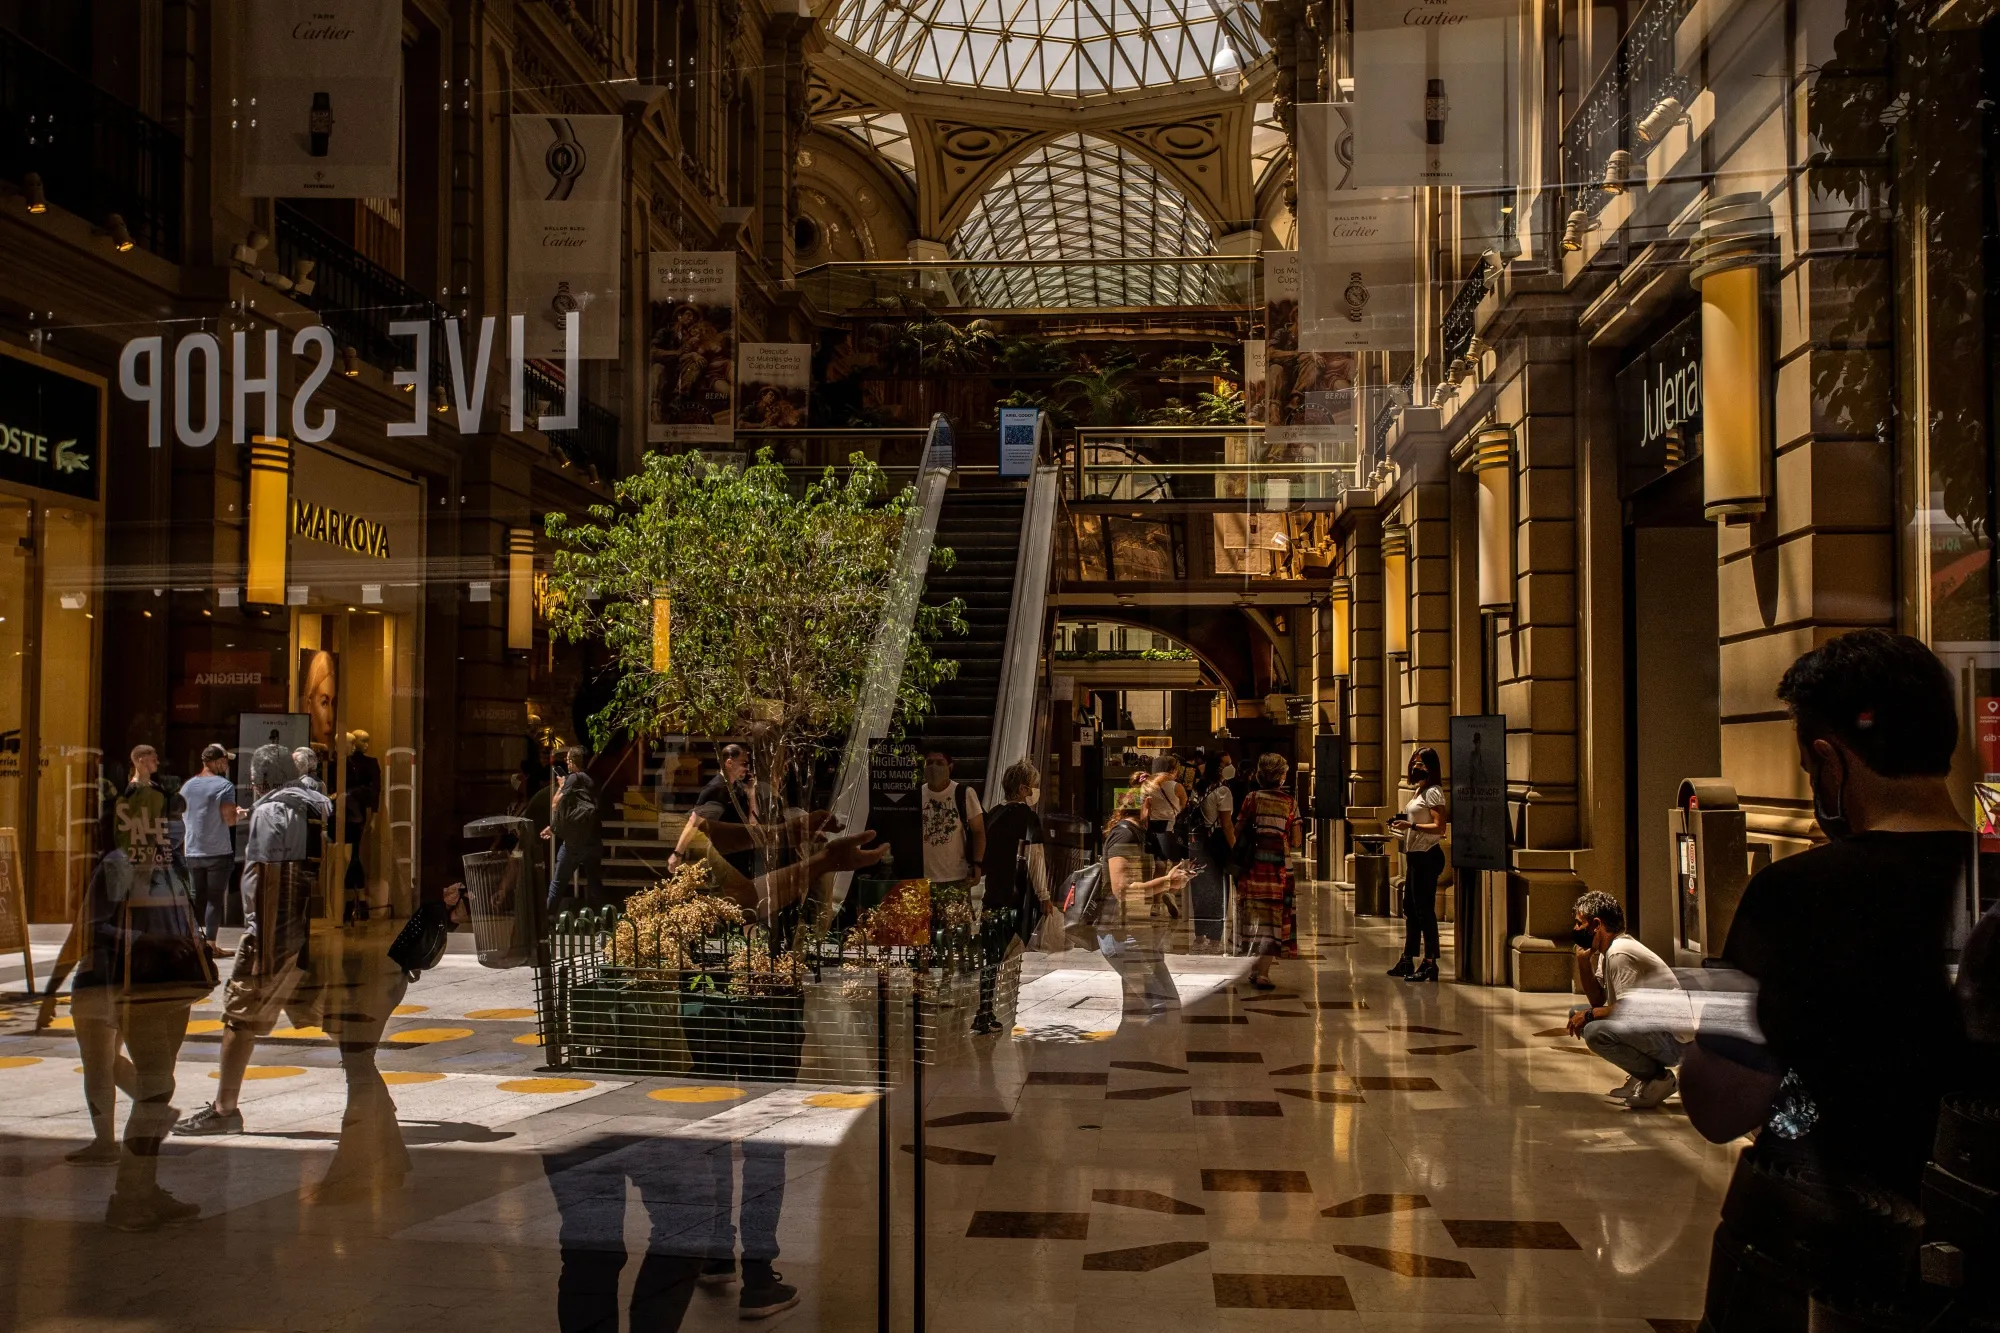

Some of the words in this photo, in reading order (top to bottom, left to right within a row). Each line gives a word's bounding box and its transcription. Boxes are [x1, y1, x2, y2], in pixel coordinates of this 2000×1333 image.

[1403, 7, 1468, 26] Cartier
[292, 21, 355, 41] Cartier
[1333, 223, 1379, 238] Cartier
[542, 233, 587, 248] Cartier
[657, 267, 669, 275] los
[702, 267, 714, 275] de
[715, 267, 724, 275] la
[692, 276, 723, 284] Central
[705, 391, 728, 400] BERNI
[1325, 392, 1348, 400] BERNI
[1640, 346, 1703, 448] Juleria
[0, 422, 48, 463] OSTE
[292, 498, 391, 560] MARKOVA
[873, 756, 917, 767] HIGIENIZA
[873, 770, 887, 779] TUS
[889, 770, 918, 779] MANO
[873, 782, 881, 790] AL
[116, 803, 171, 845] SALE
[128, 846, 163, 863] 25%
